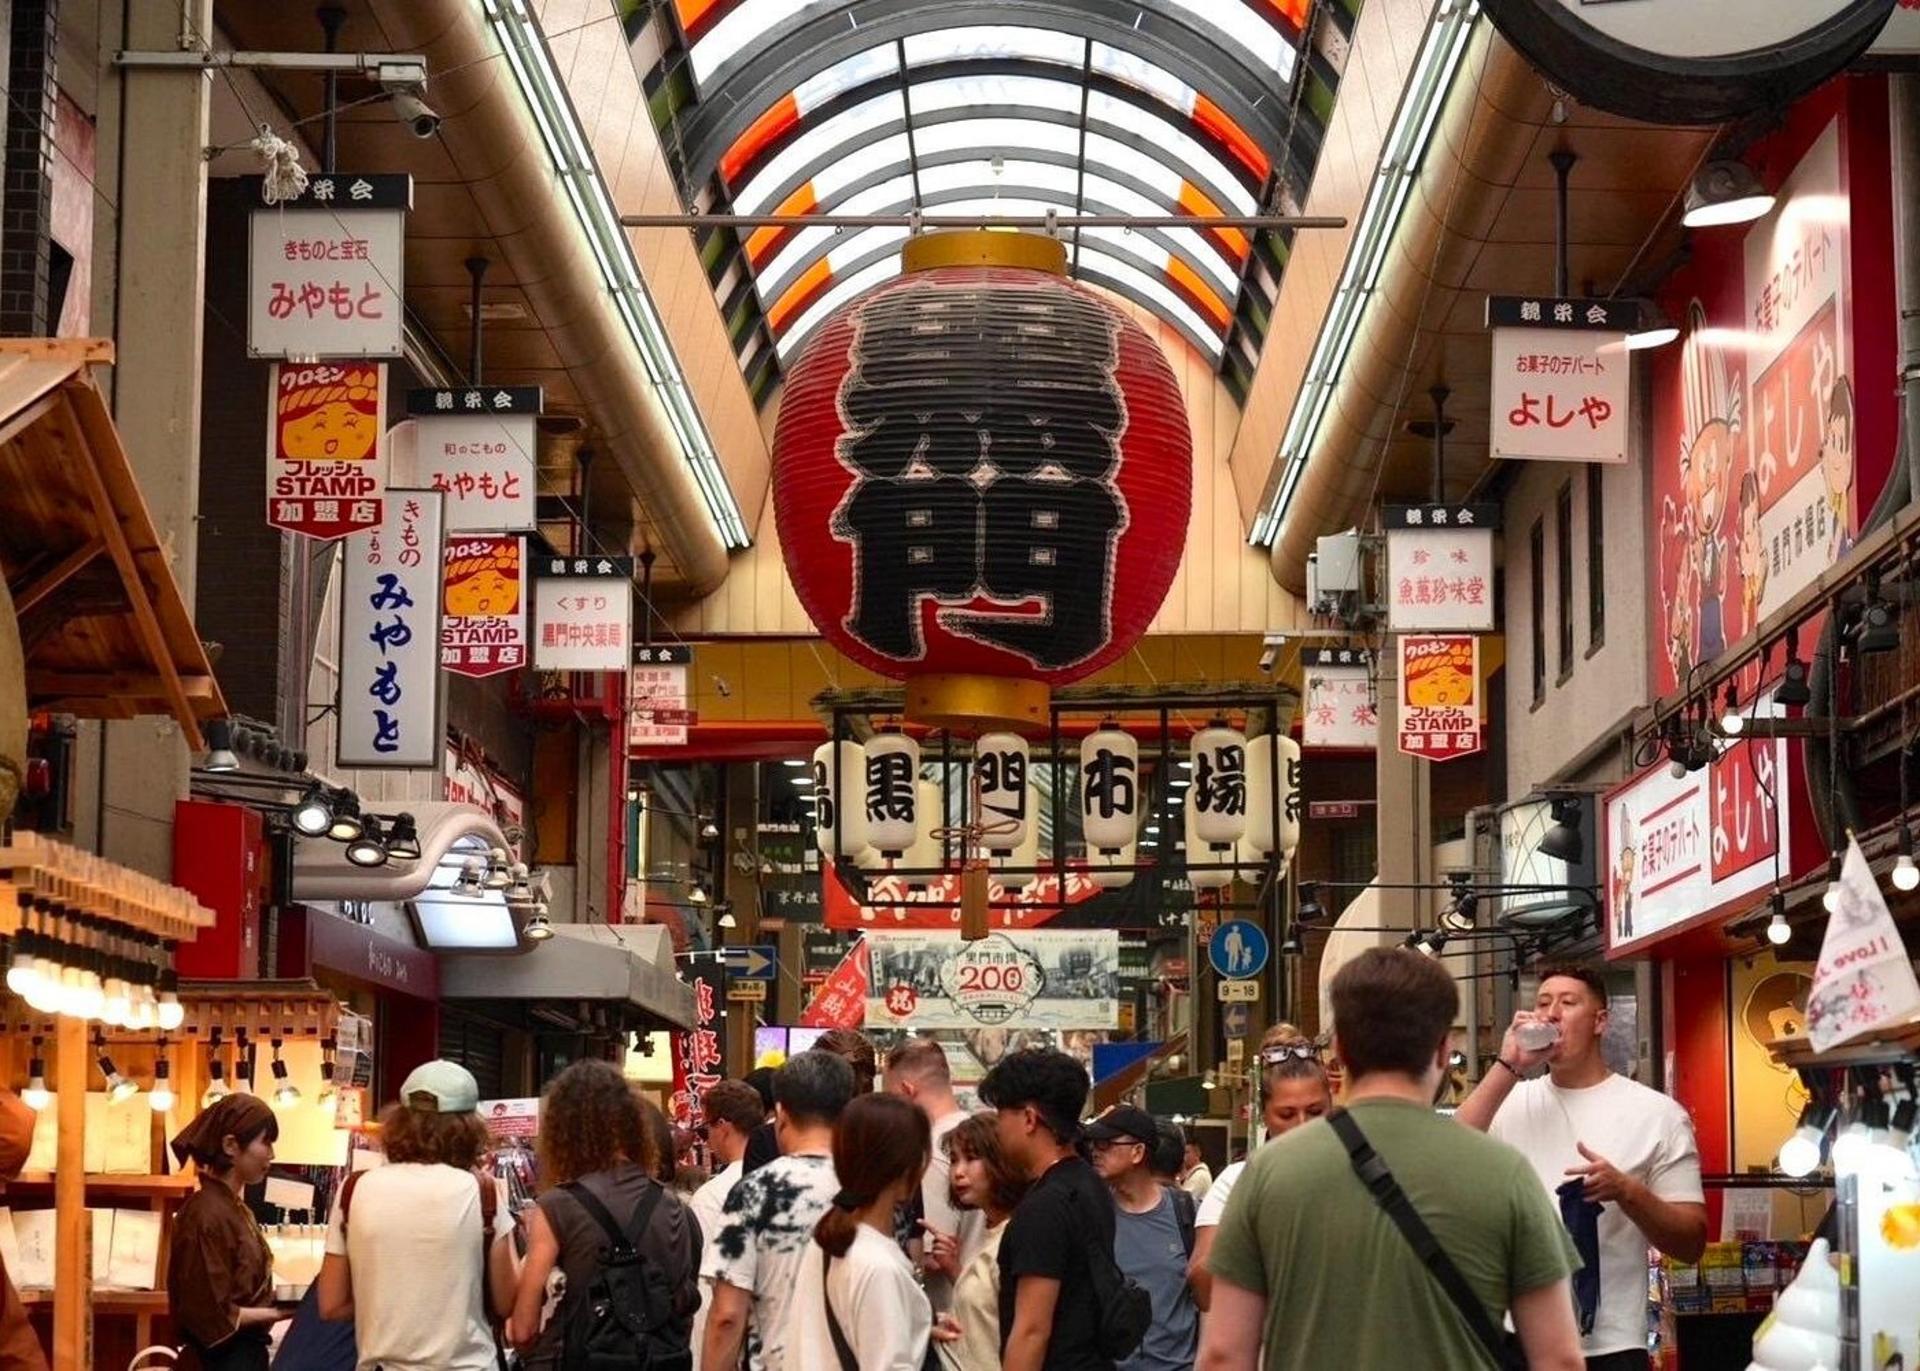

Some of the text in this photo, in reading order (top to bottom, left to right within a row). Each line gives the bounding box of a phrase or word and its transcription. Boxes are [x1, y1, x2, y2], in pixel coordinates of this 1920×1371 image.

[284, 240, 369, 261] きものと宝石
[268, 280, 383, 320] みやもと
[1519, 301, 1609, 325] 親栄会
[1516, 353, 1605, 376] お菓子のデパート
[280, 366, 345, 391] クロモン
[434, 389, 513, 410] 親栄会
[1508, 391, 1612, 430] よしや
[1758, 330, 1834, 496] よしや
[444, 442, 507, 456] 和のこもの
[284, 460, 365, 477] フレッシュ
[276, 476, 376, 497] STAMP
[432, 470, 520, 501] みやもと
[276, 500, 376, 523] 加盟店
[1405, 508, 1475, 525] 親栄会
[398, 499, 421, 568] きもの
[444, 541, 494, 563] クロモン
[1412, 548, 1470, 565] 珍味
[550, 559, 613, 574] 親栄会
[556, 596, 608, 612] くすり
[447, 616, 510, 629] フレッシュ
[441, 628, 519, 645] STAMP
[542, 623, 622, 648] 黒門中央薬局
[441, 647, 519, 665] 加盟店
[639, 648, 673, 662] 栄会
[1405, 640, 1451, 660] クロモン
[369, 573, 414, 754] みやもと
[1410, 706, 1465, 718] フレッシュ
[1404, 717, 1474, 731] STAMP
[1404, 733, 1474, 750] 加盟店
[865, 751, 915, 823] 黒
[975, 749, 1025, 821] 門
[1084, 748, 1135, 819] 市
[1194, 744, 1246, 816] 場
[1712, 744, 1777, 865] よしや
[1640, 807, 1700, 880] お菓子のデパート
[966, 951, 1018, 965] 黒門市場
[959, 965, 1022, 992] 200
